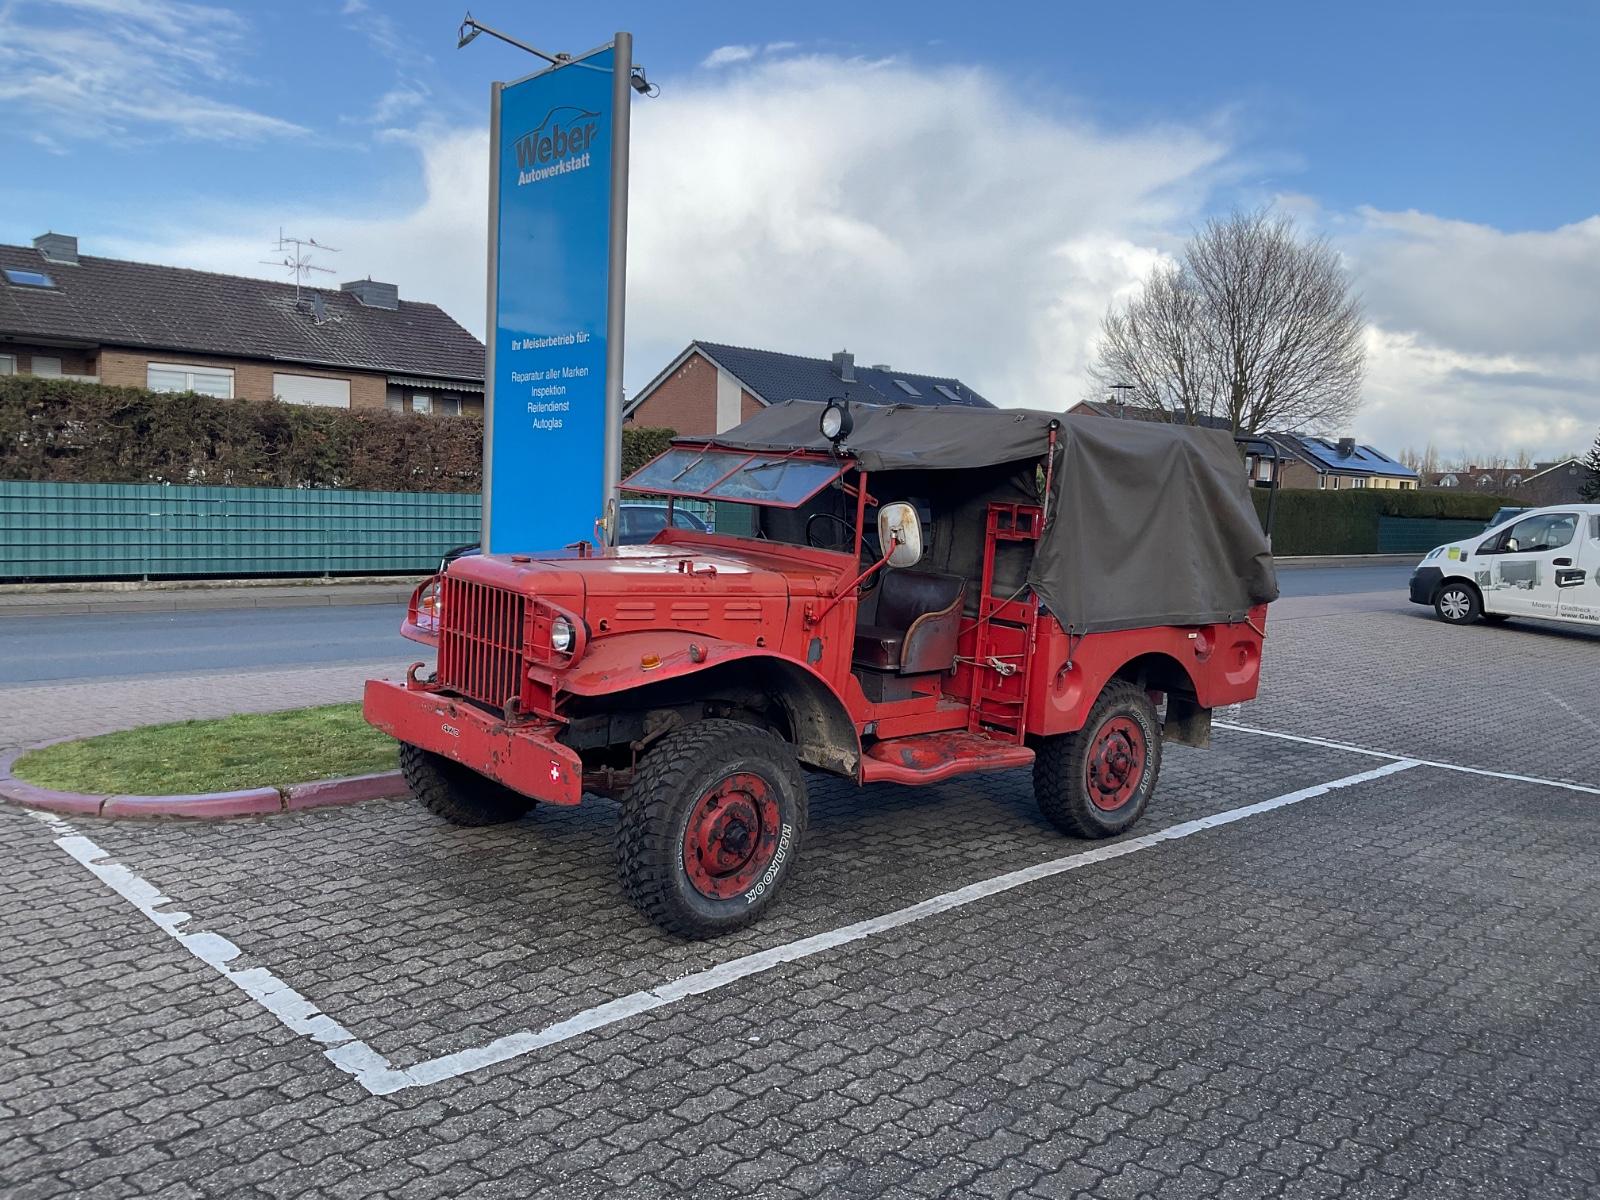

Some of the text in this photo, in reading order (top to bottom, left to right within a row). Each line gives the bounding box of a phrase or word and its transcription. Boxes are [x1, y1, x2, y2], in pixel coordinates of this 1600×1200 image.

[516, 122, 596, 168] Weber
[517, 152, 591, 186] Autowerkstatt
[511, 331, 590, 351] Ihr Meisterbetrieb für:
[511, 365, 589, 384] Reparatur aller Marken
[531, 384, 567, 399] Inspektion
[527, 400, 570, 414] Reifendienst
[532, 417, 563, 431] Autoglas
[1560, 612, 1600, 621] www.GeMo
